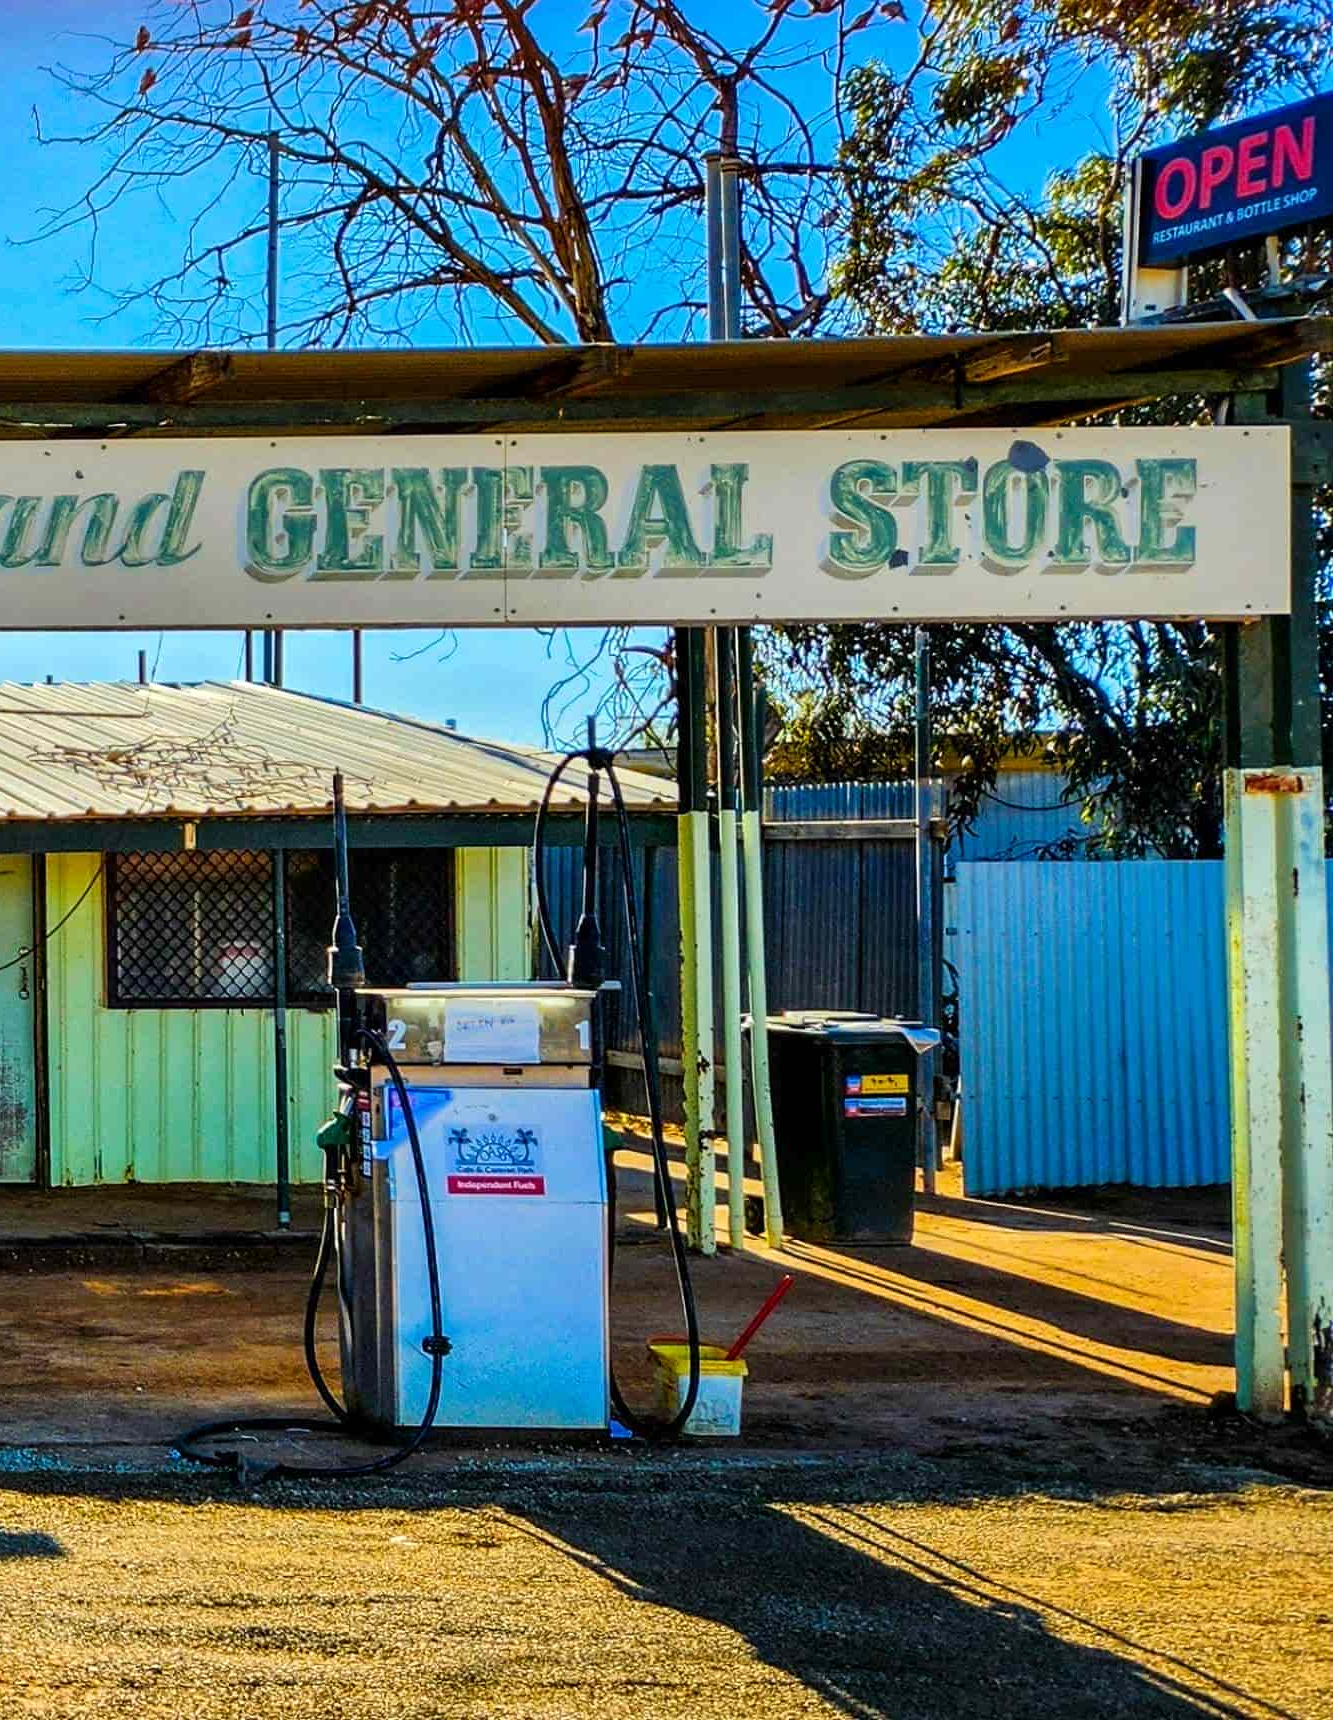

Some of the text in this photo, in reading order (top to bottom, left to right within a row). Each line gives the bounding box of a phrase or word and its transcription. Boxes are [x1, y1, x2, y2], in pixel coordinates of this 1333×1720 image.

[1154, 115, 1316, 220] OPEN
[1152, 186, 1318, 244] RESTAURANT & BOTTLE SHOP
[241, 463, 773, 580] GENERAL
[821, 457, 1200, 579] STORE
[388, 1019, 407, 1050] 2
[575, 1020, 590, 1050] 1
[457, 1180, 536, 1191] Independent Fuels
